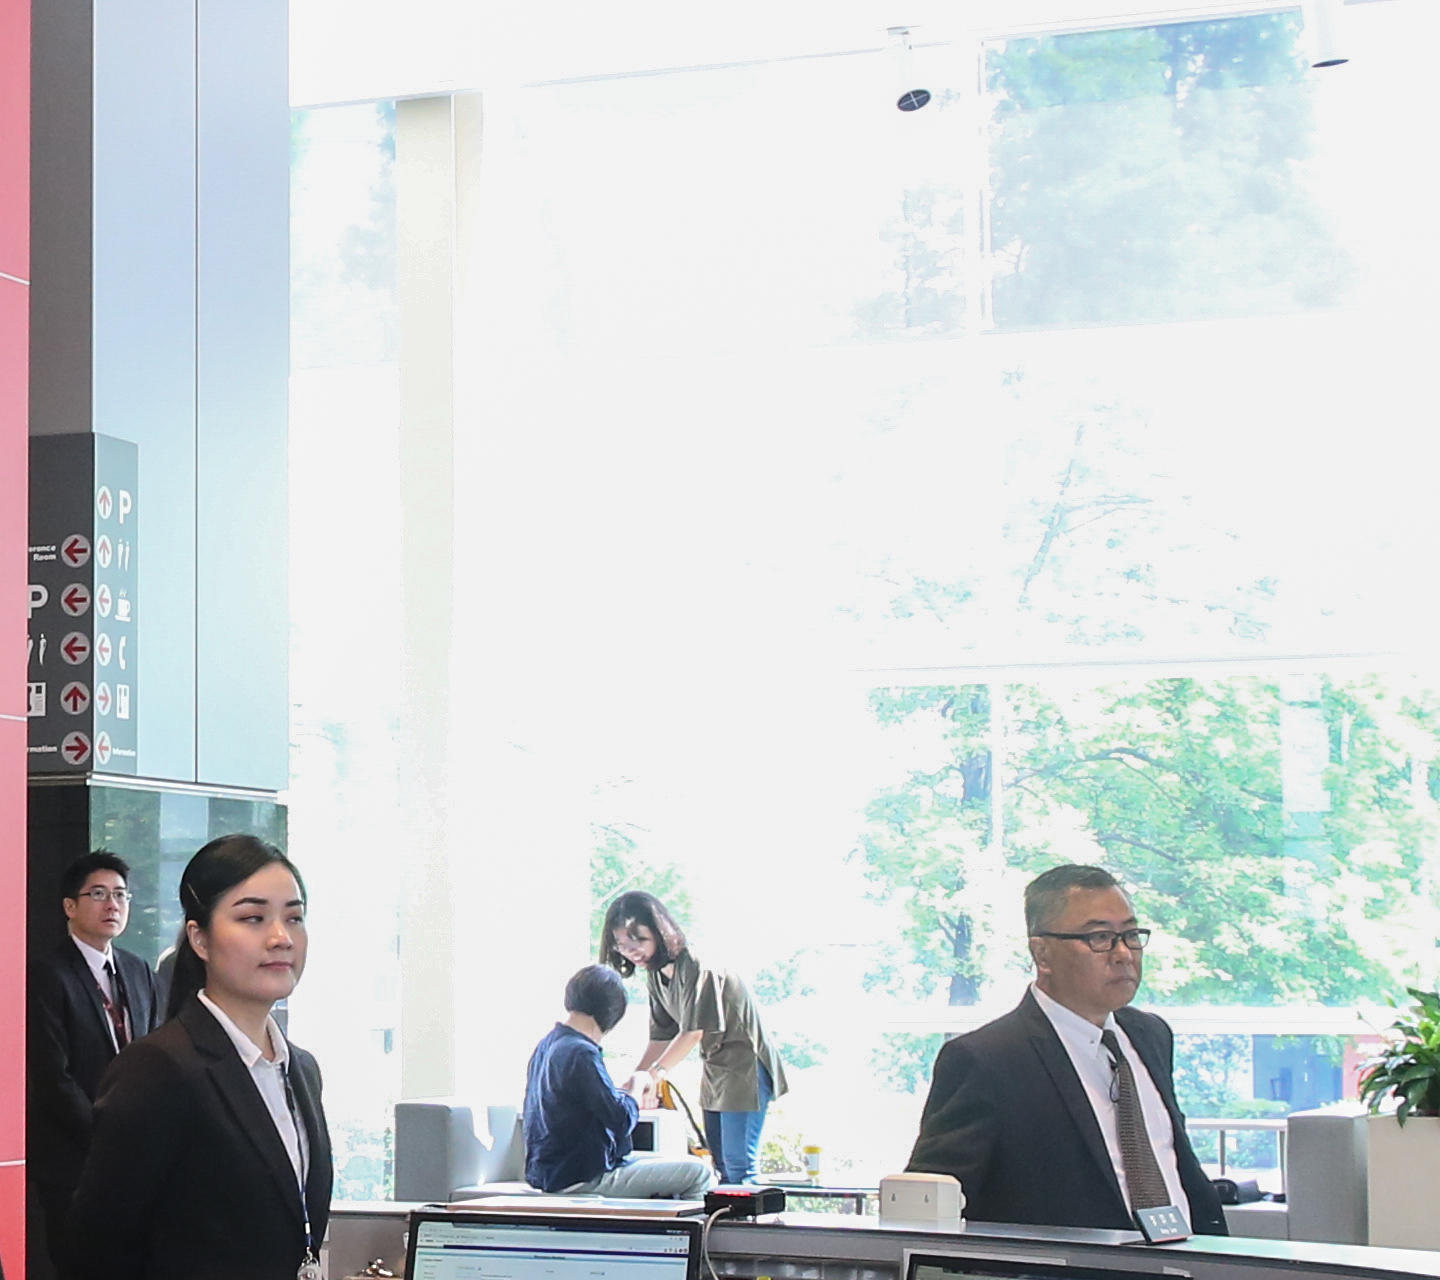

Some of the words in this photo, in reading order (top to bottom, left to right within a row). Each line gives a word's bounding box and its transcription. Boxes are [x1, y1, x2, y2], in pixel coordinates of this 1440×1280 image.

[119, 490, 132, 524] P
[28, 545, 56, 553] erence
[27, 583, 49, 619] P
[28, 745, 57, 753] mation
